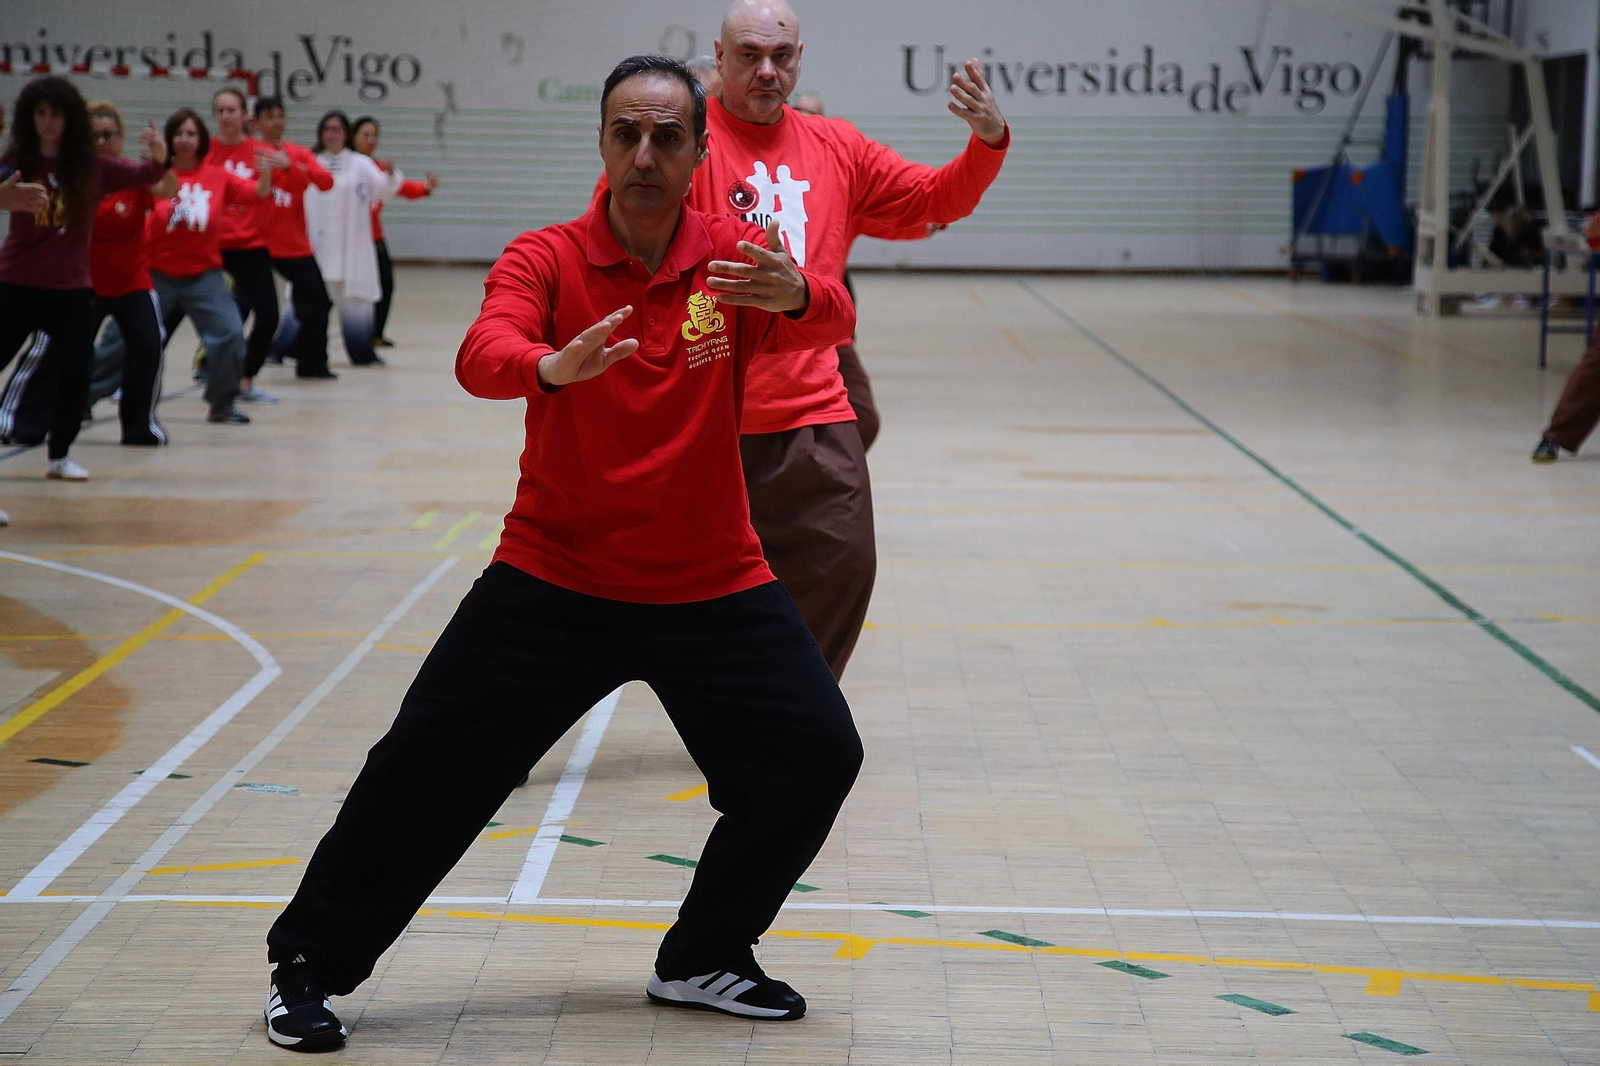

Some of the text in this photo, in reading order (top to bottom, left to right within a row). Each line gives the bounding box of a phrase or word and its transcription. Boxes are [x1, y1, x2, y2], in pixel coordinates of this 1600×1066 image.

[256, 50, 313, 102] de
[298, 33, 421, 105] Vigo
[1189, 63, 1250, 113] de
[1238, 45, 1362, 115] Vigo
[711, 344, 730, 354] QUAN
